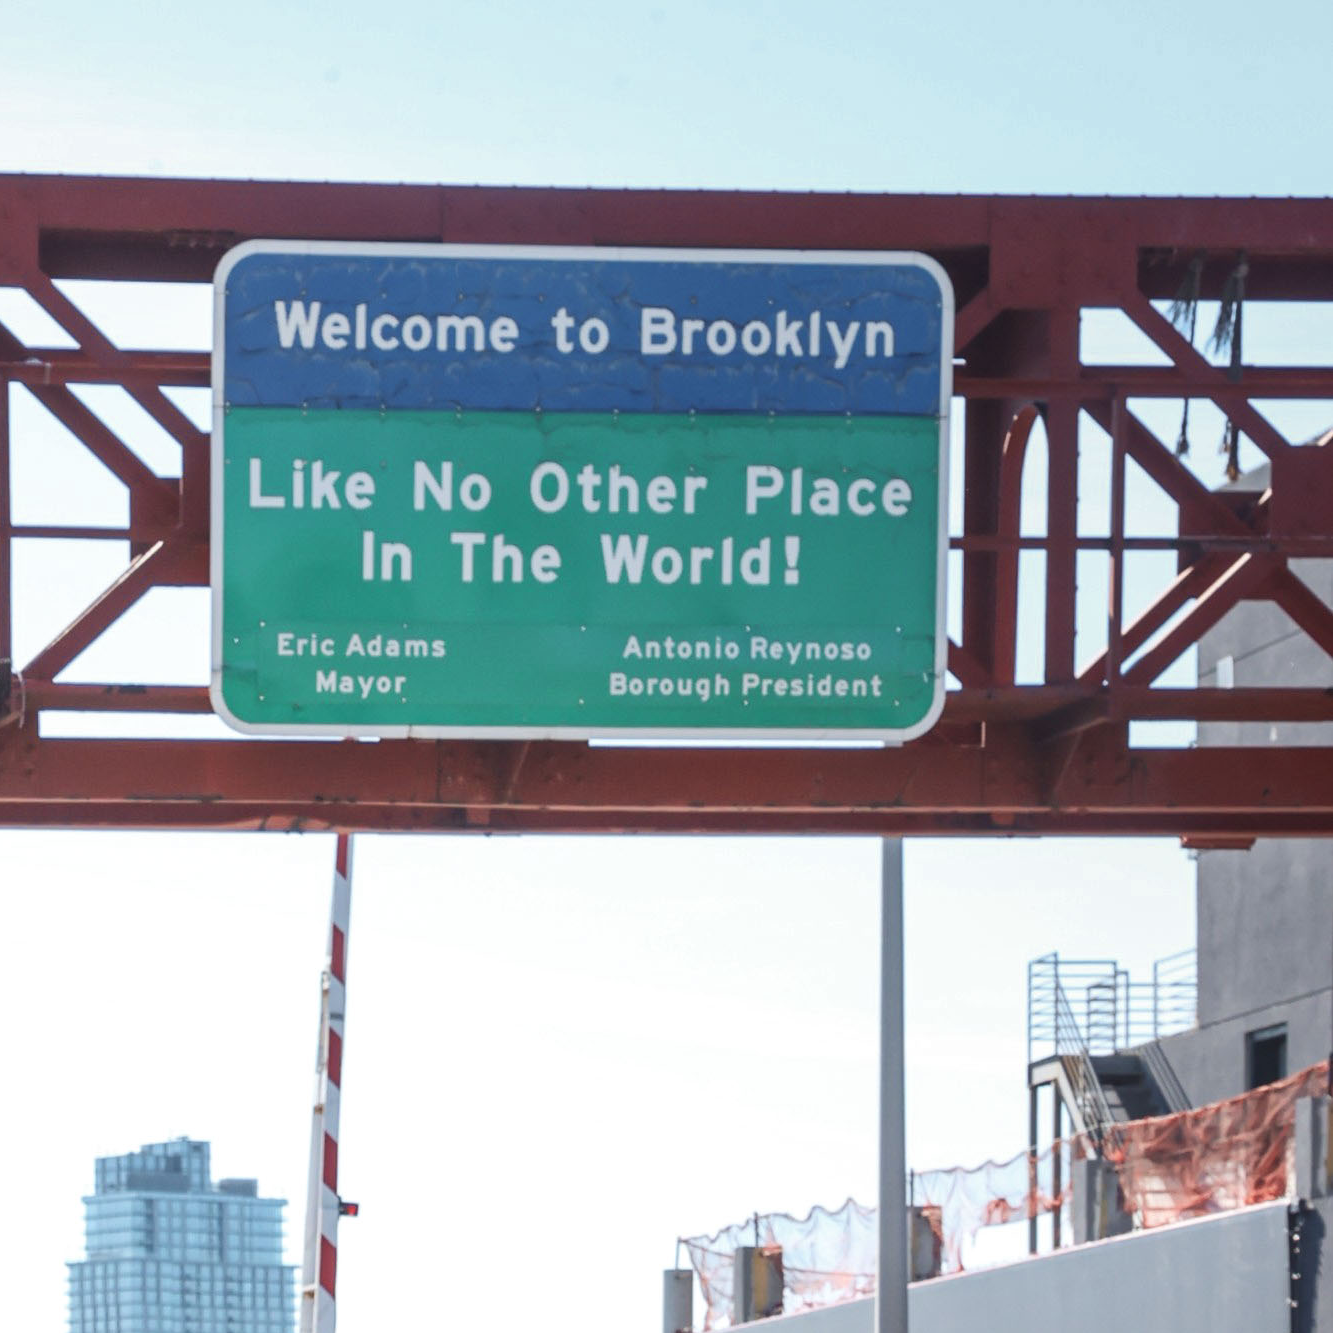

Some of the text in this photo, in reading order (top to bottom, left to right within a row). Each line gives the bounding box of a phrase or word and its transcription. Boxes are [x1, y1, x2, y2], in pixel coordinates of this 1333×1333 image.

[274, 301, 896, 369] Welcome to Brooklyn
[249, 458, 914, 517] Like No Other Place
[362, 530, 802, 587] In The World!
[276, 632, 447, 659] Eric Adams
[623, 635, 872, 667] Antonio Reynoso
[316, 668, 407, 698] Mayor
[609, 672, 883, 703] Borough President
